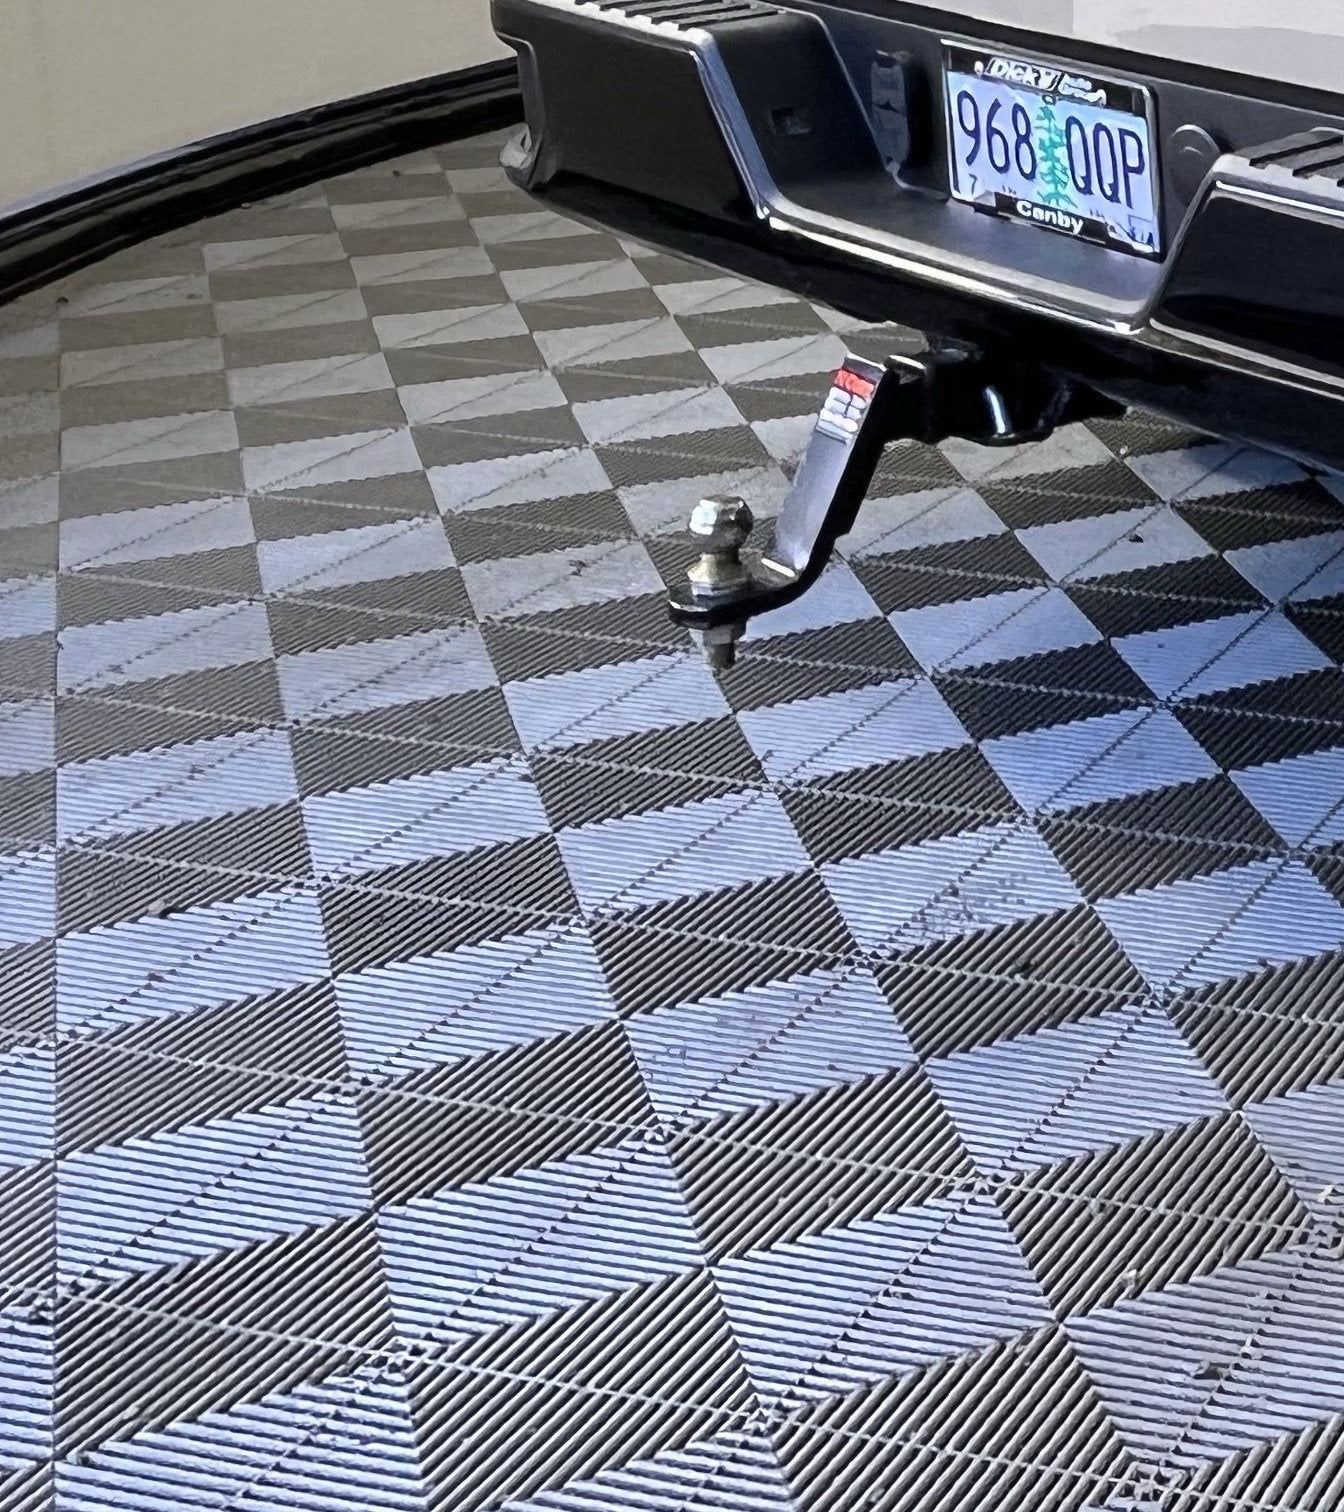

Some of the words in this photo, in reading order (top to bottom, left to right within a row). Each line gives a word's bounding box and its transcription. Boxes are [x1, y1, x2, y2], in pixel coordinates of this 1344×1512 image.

[956, 90, 1037, 181] 968
[1065, 115, 1145, 210] QQP
[1016, 200, 1083, 235] Canby
